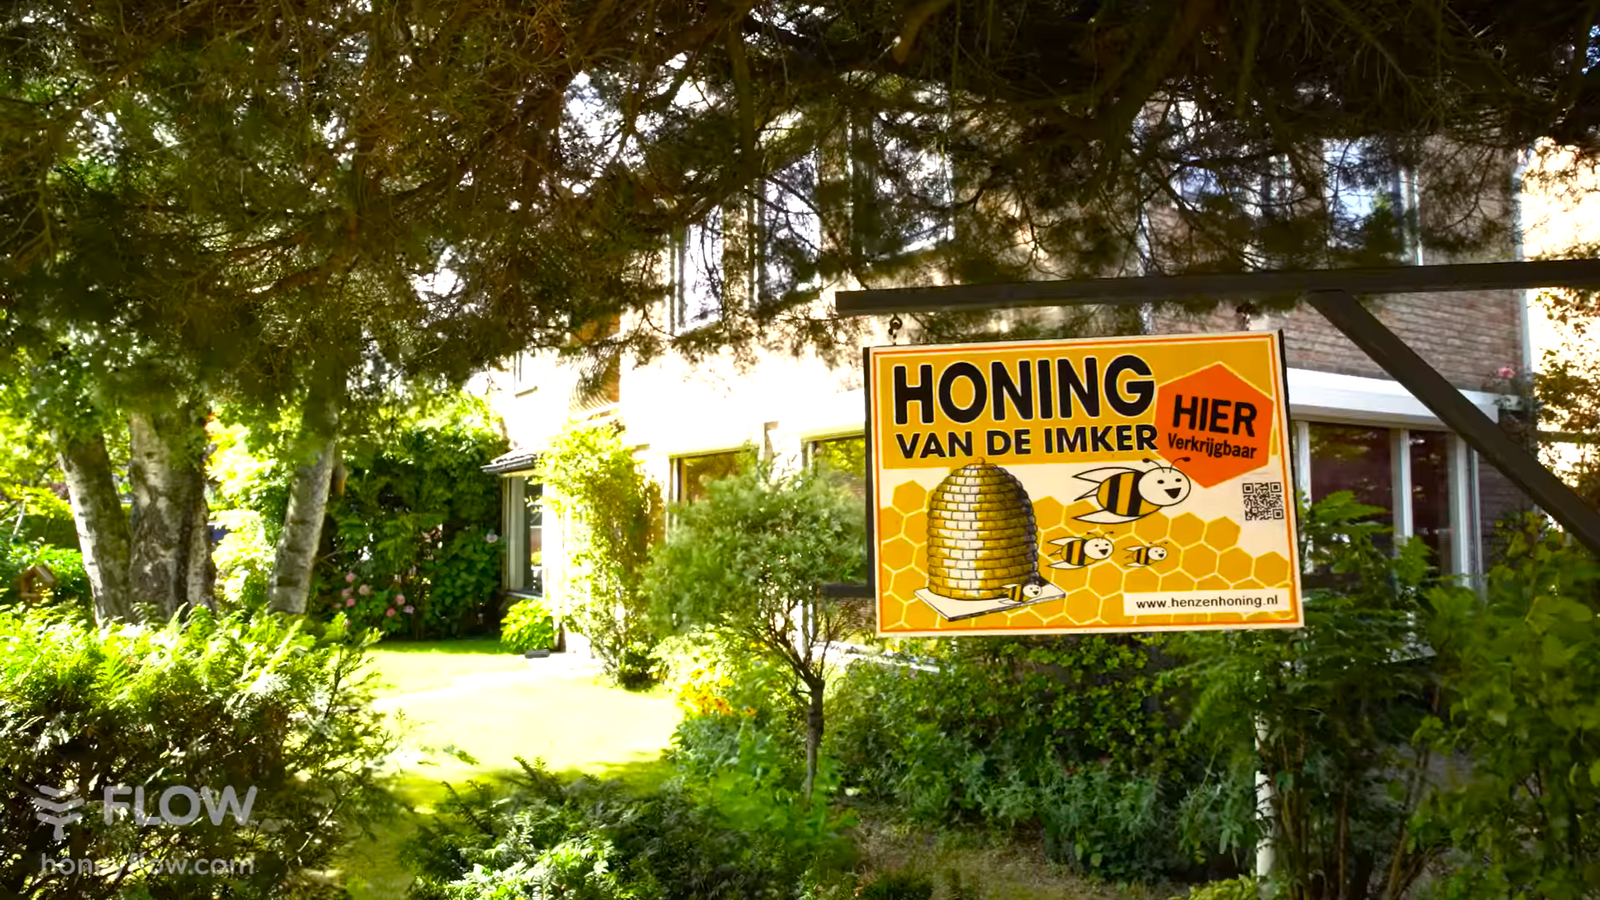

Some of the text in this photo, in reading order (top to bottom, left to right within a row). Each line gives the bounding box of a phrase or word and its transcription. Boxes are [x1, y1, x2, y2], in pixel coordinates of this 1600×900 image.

[893, 354, 1156, 425] HONING
[1172, 394, 1258, 438] HIER
[895, 424, 1158, 459] VAN DE IMKER
[1167, 432, 1258, 460] Verkrijgbaar
[1135, 593, 1279, 611] www.henzenhoning.nl
